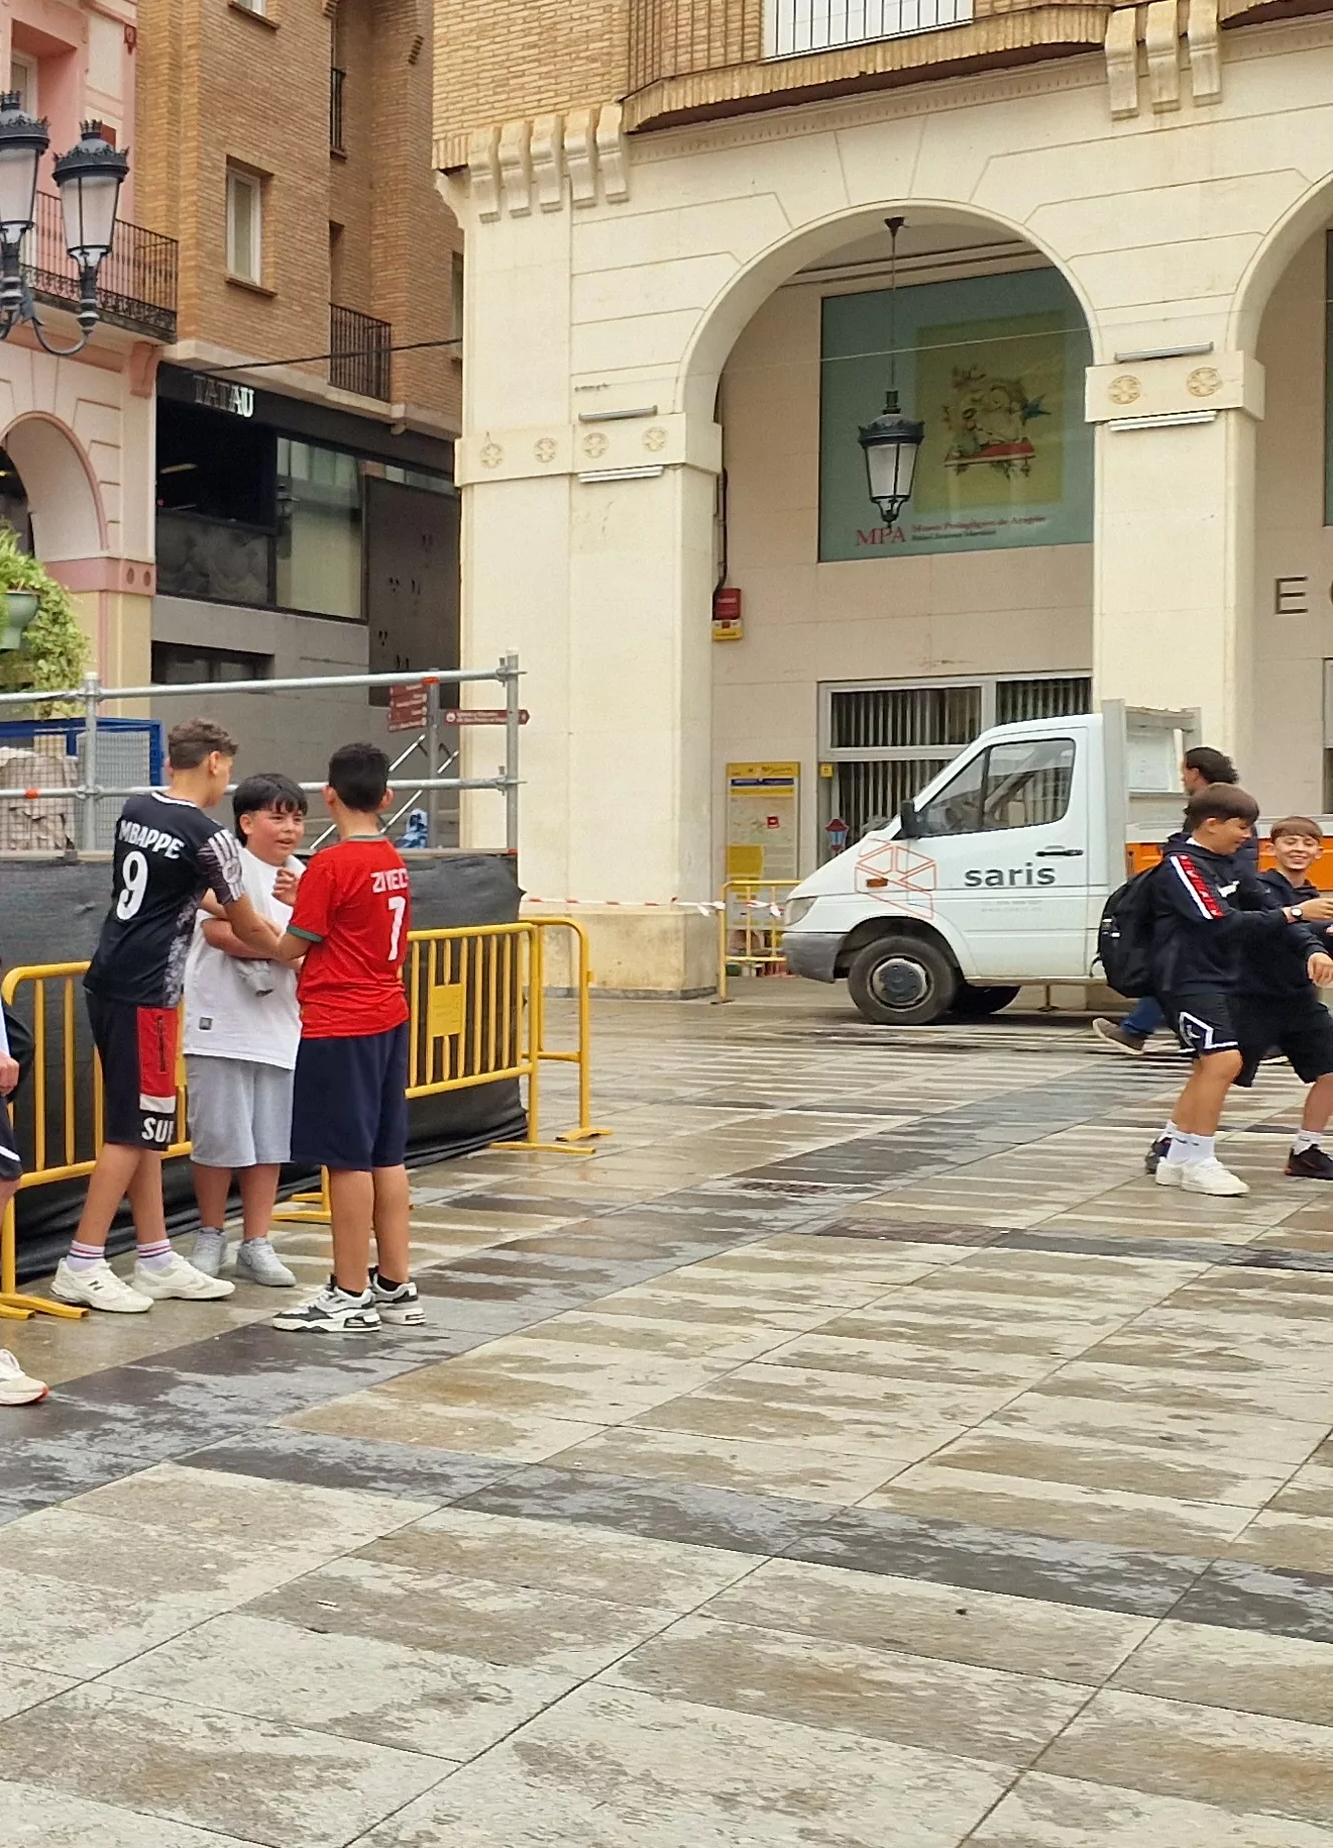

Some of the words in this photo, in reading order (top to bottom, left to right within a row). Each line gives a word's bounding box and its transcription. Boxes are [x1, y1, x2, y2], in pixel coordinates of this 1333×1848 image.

[193, 375, 254, 417] TATAU
[856, 526, 907, 546] MPA
[119, 820, 185, 859] MBAPPE
[116, 850, 148, 920] 9
[964, 861, 1056, 887] saris
[388, 895, 406, 961] 7
